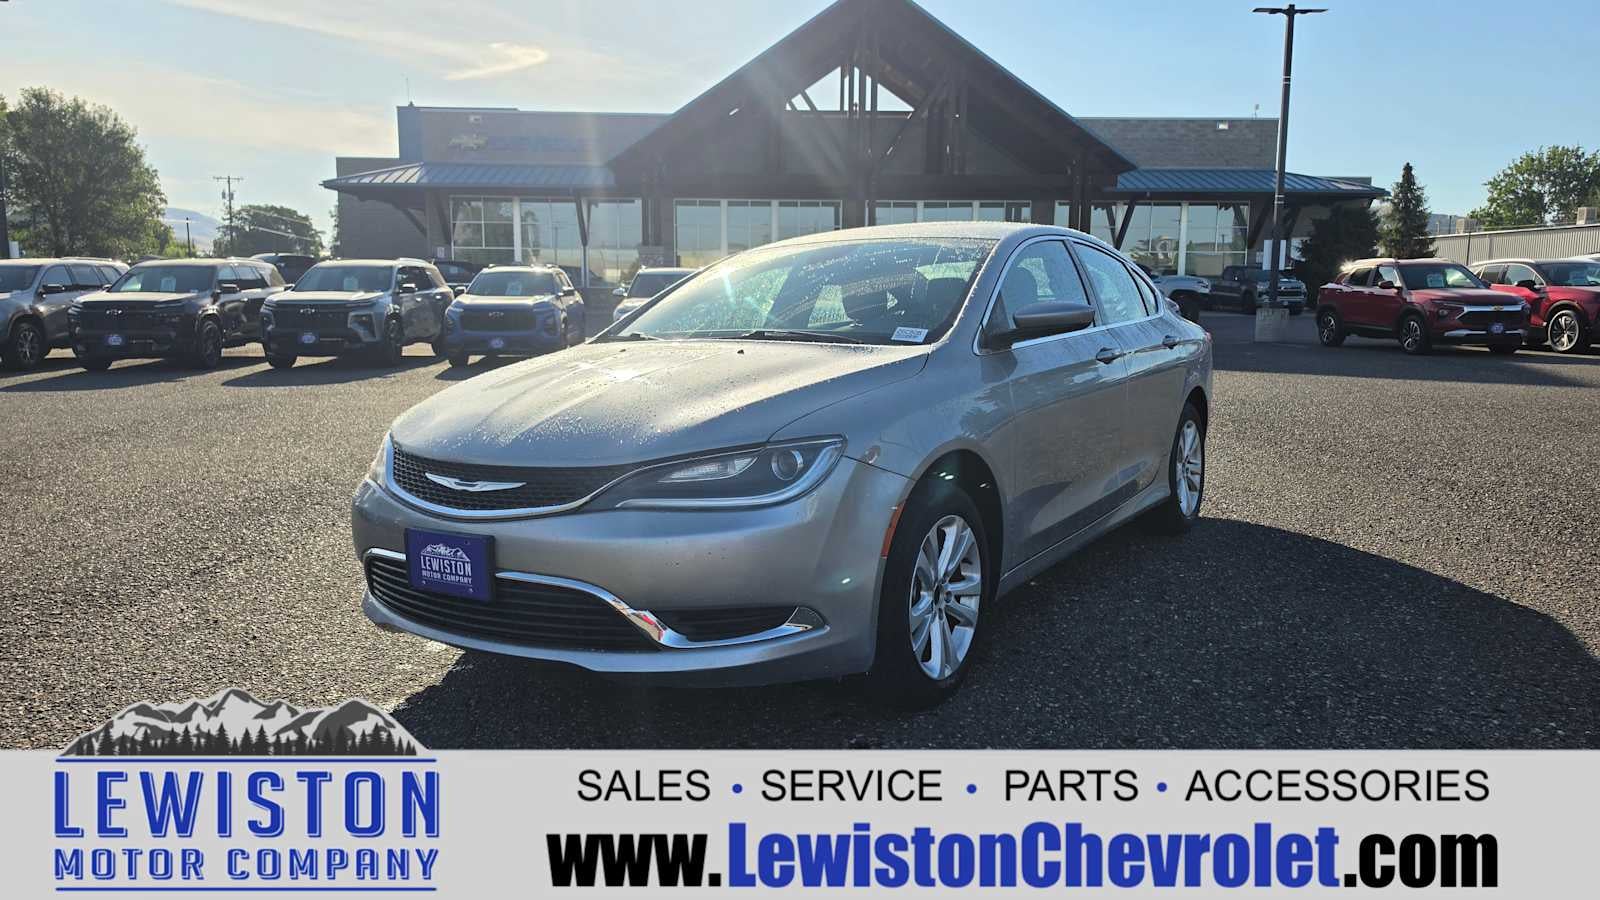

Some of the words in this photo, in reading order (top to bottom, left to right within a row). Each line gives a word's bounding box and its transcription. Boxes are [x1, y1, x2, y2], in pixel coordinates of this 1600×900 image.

[420, 556, 472, 577] LEWISTON
[421, 570, 441, 580] MOTOR
[442, 573, 472, 585] COMPANY
